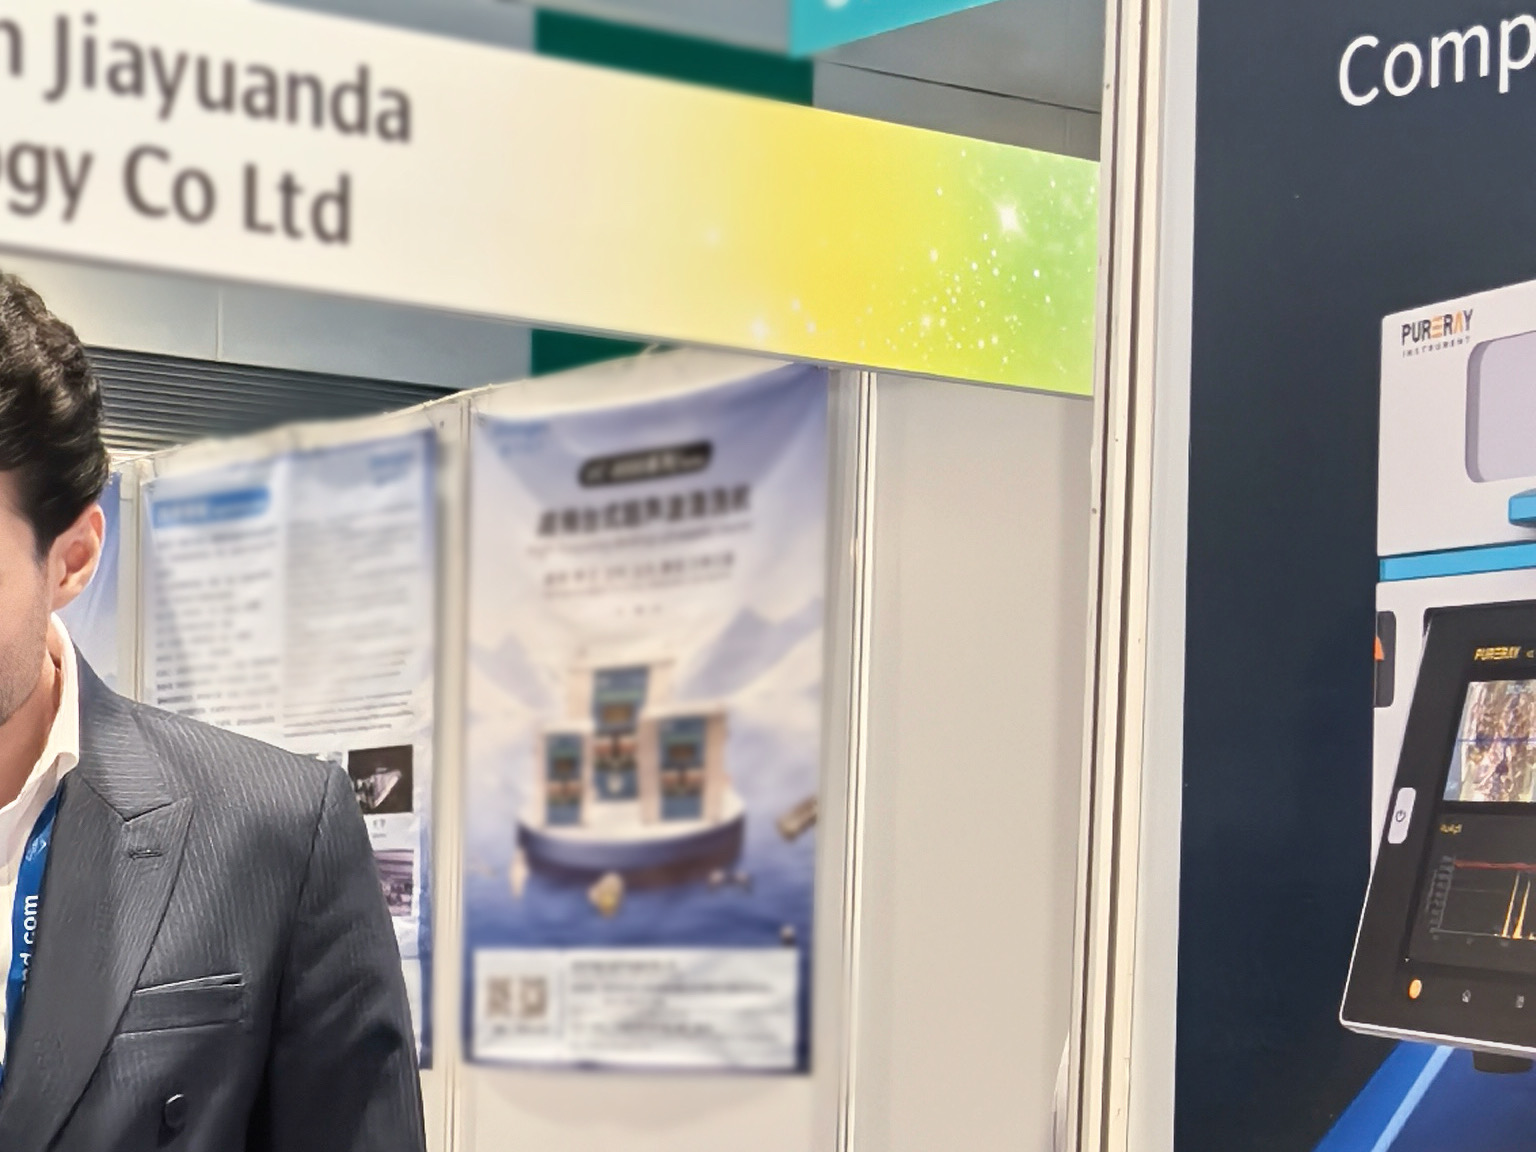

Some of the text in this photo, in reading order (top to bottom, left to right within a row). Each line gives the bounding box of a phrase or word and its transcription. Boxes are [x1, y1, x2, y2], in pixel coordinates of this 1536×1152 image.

[42, 11, 413, 144] Jiayuanda
[1339, 14, 1536, 107] Comp
[122, 143, 217, 226] Co
[243, 162, 352, 247] Ltd
[1401, 308, 1473, 346] PURERAY
